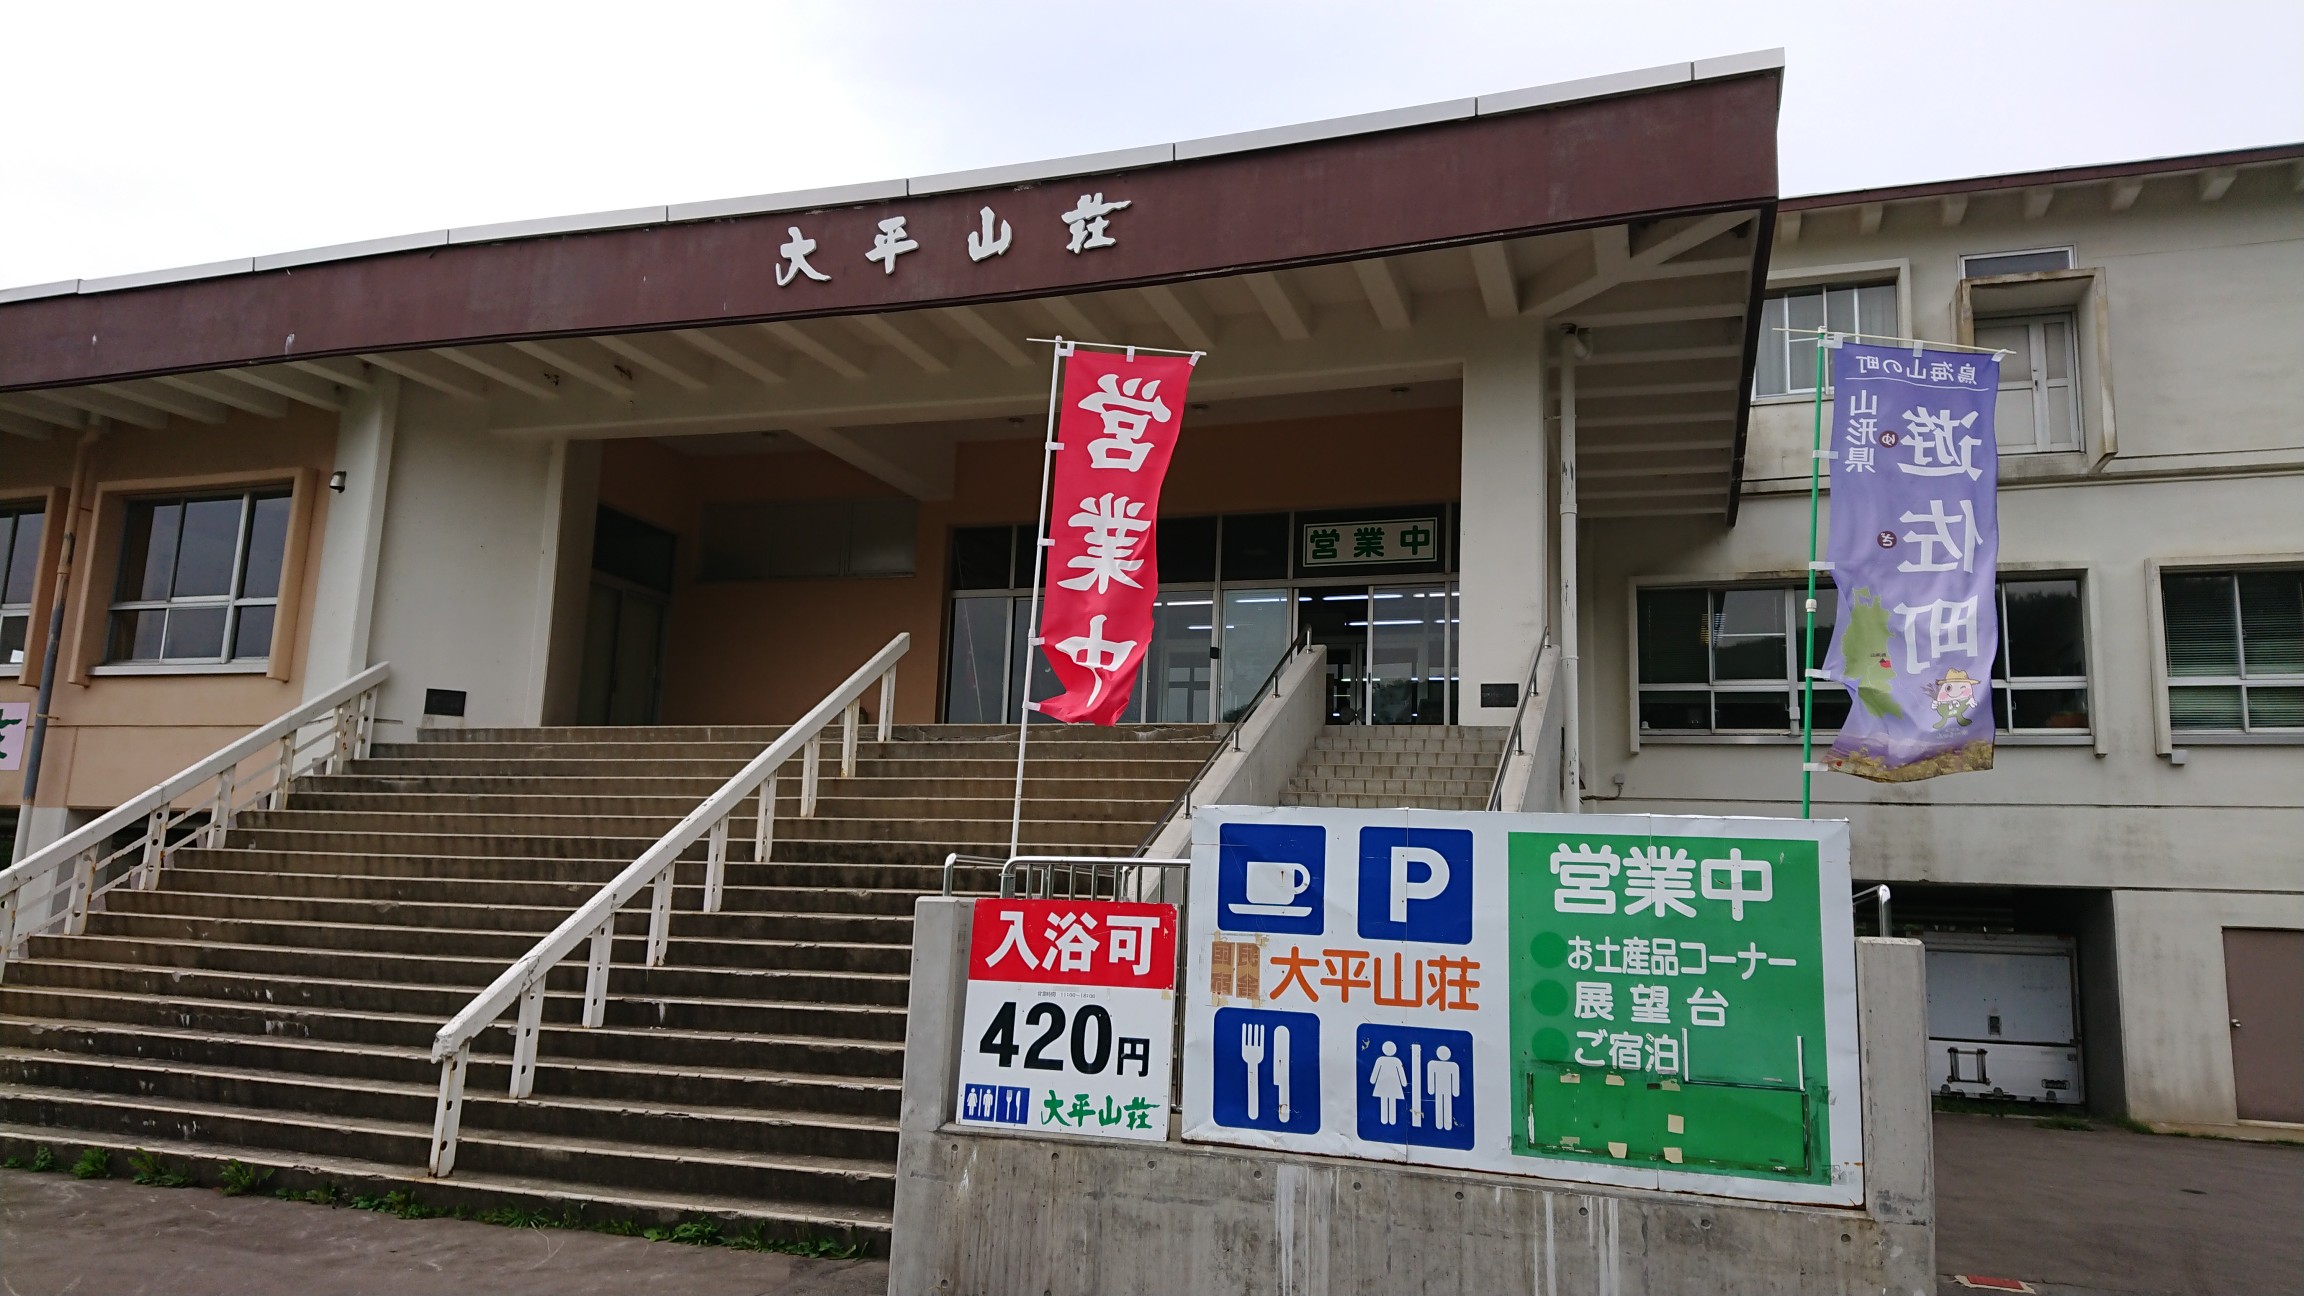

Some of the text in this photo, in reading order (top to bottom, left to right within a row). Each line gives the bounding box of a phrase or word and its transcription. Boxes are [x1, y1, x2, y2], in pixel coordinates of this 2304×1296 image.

[775, 192, 1132, 287] 大平山荘
[1055, 373, 1172, 708] 営業中
[1310, 525, 1430, 560] 営業中
[1390, 846, 1450, 923] P
[1550, 843, 1773, 922] 営業中
[985, 910, 1161, 976] 入浴可
[1567, 935, 1797, 980] お土産品コーナー
[1269, 946, 1481, 1012] 大平山荘
[1574, 981, 1729, 1027] 展望台
[979, 1001, 1150, 1078] 420円
[1574, 1028, 1679, 1075] ご宿泊
[1040, 1089, 1161, 1131] 大平山荘
